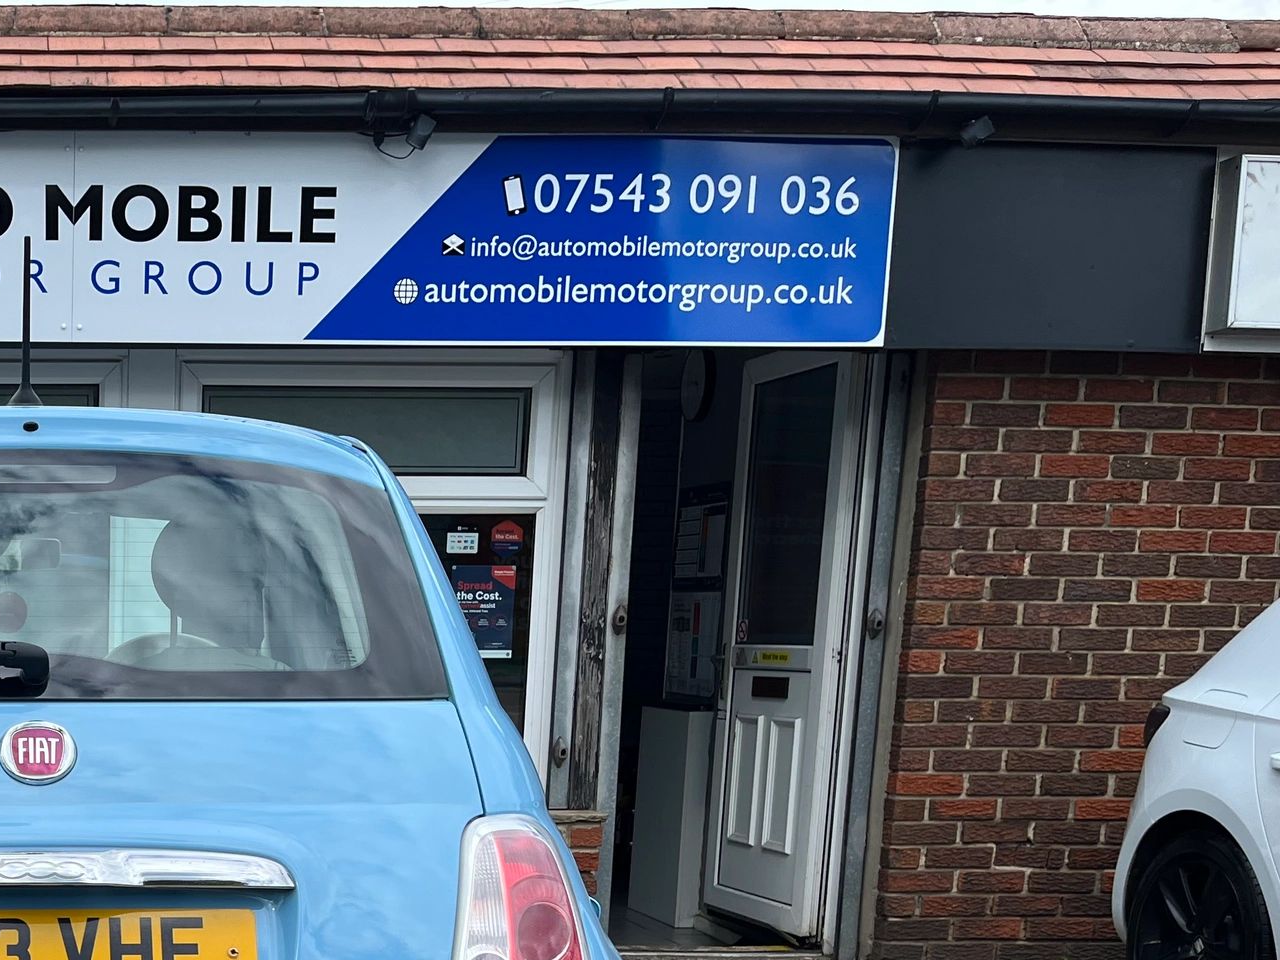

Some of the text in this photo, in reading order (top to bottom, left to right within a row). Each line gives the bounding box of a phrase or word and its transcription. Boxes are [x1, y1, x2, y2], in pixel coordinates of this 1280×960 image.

[533, 172, 860, 216] 07543 091 036
[45, 184, 338, 243] MOBILE
[470, 235, 857, 263] info@automobilemotorgroup.co.uk
[90, 260, 320, 296] GROUP
[423, 276, 853, 312] automobilemotorgroup.co.uk
[456, 591, 502, 600] the Cost.
[457, 581, 493, 592] Spread
[17, 737, 60, 765] FIAT
